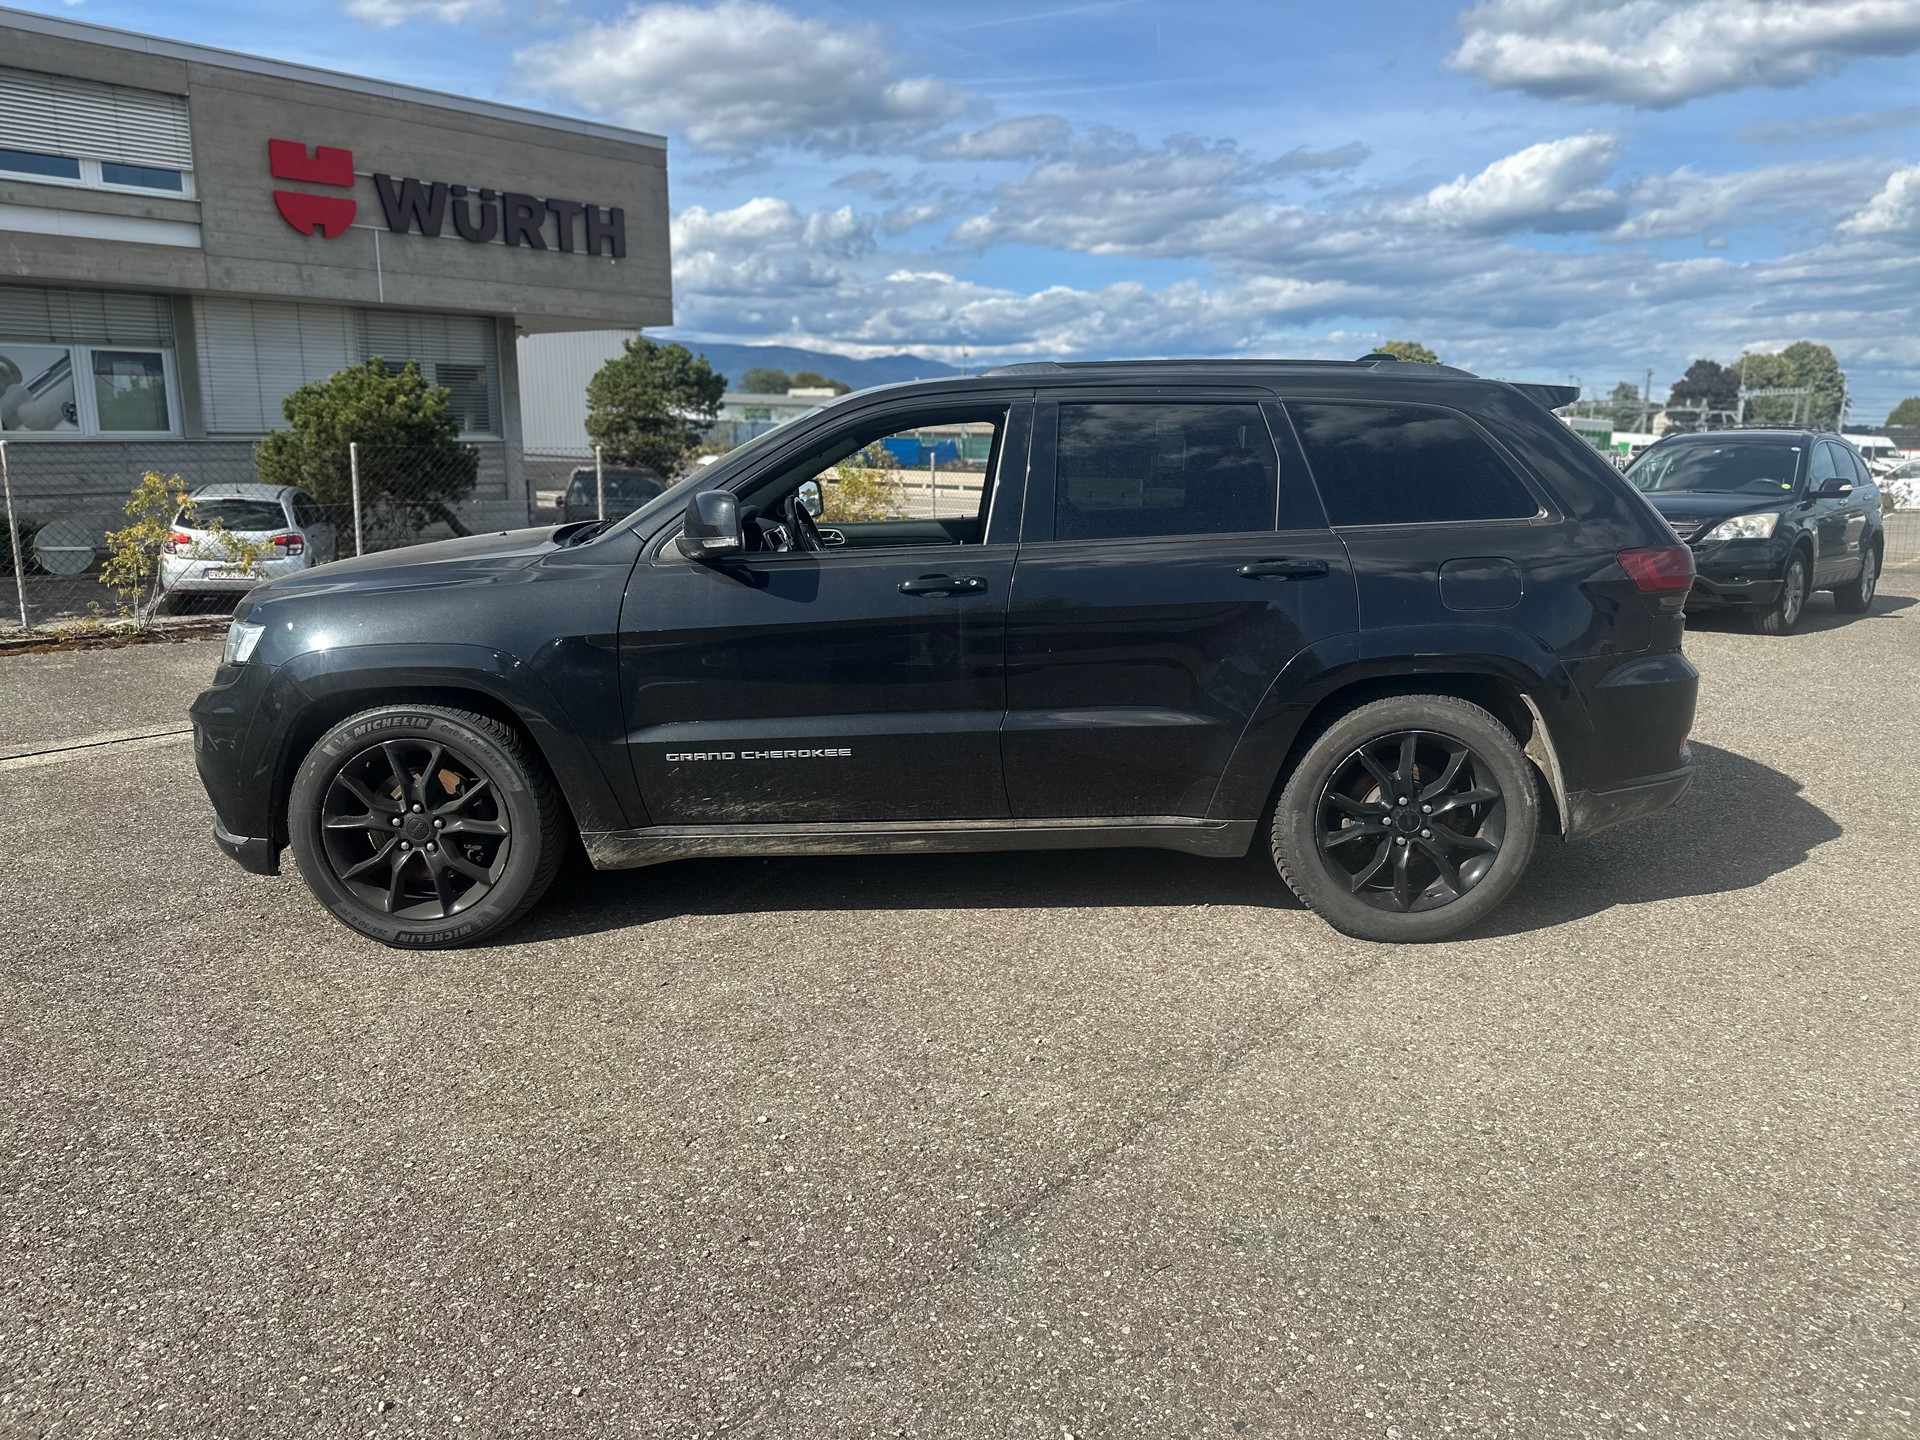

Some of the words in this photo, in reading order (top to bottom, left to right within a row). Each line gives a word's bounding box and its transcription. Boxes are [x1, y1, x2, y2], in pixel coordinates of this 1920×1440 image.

[373, 173, 626, 258] WÜRTH
[354, 717, 429, 737] MICHELIN
[665, 752, 736, 762] GRAND
[741, 748, 852, 760] CHEROKEE
[400, 922, 473, 944] MICHELIN
